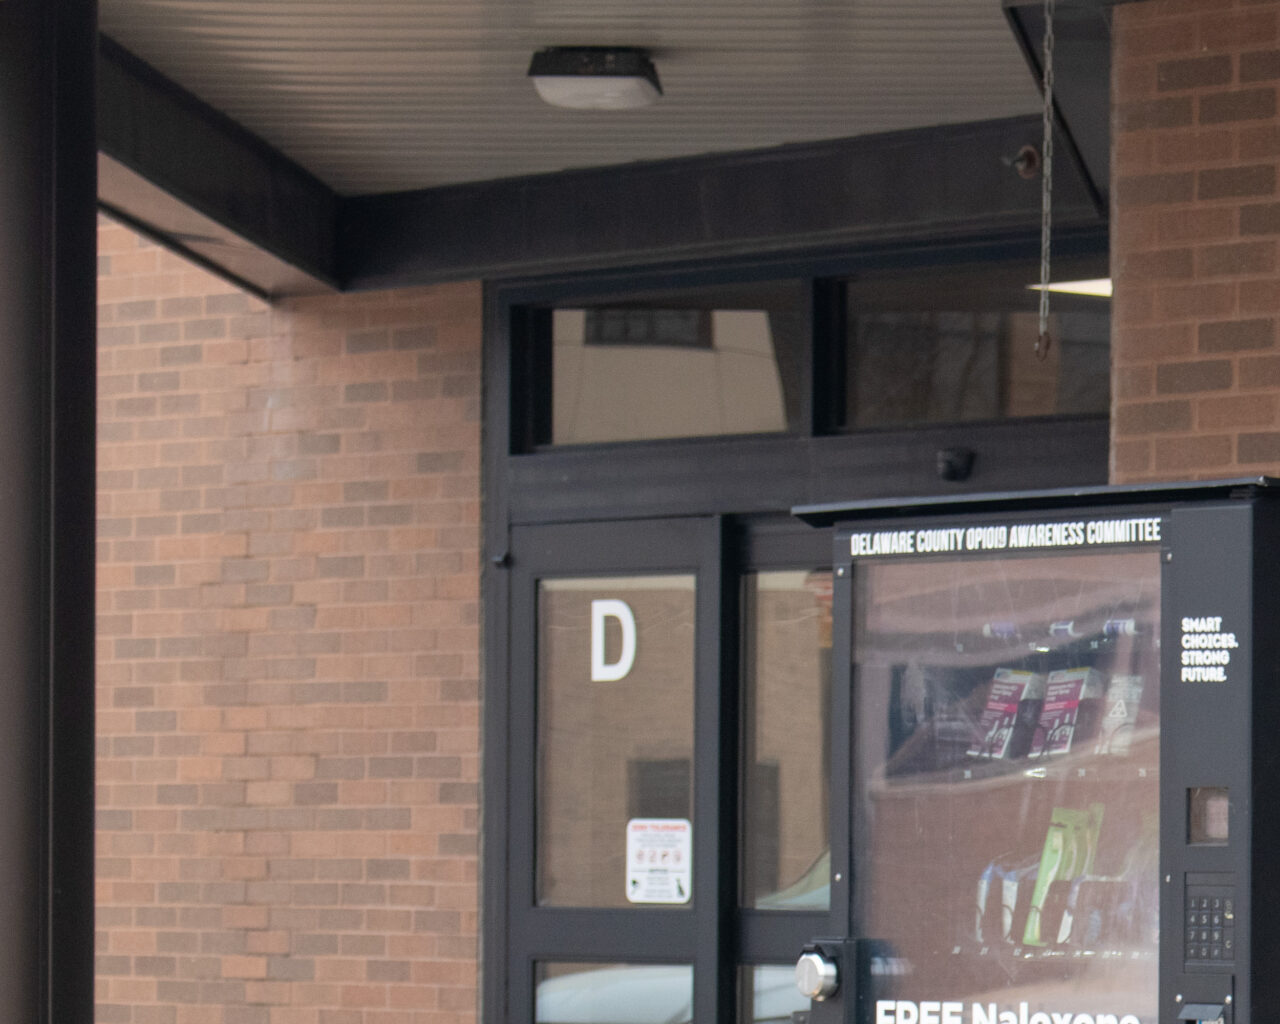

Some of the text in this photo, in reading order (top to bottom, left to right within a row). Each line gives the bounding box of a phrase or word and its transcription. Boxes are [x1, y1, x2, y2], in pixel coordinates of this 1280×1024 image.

[851, 516, 1162, 556] DELAWARE COUNTY OPIOID AWARENESS COMMITTEE
[1181, 616, 1222, 632] SMART
[591, 599, 637, 682] D
[1181, 633, 1239, 649] CHOICES.
[1181, 649, 1230, 666] STRONG
[1181, 666, 1227, 682] FUTURE.
